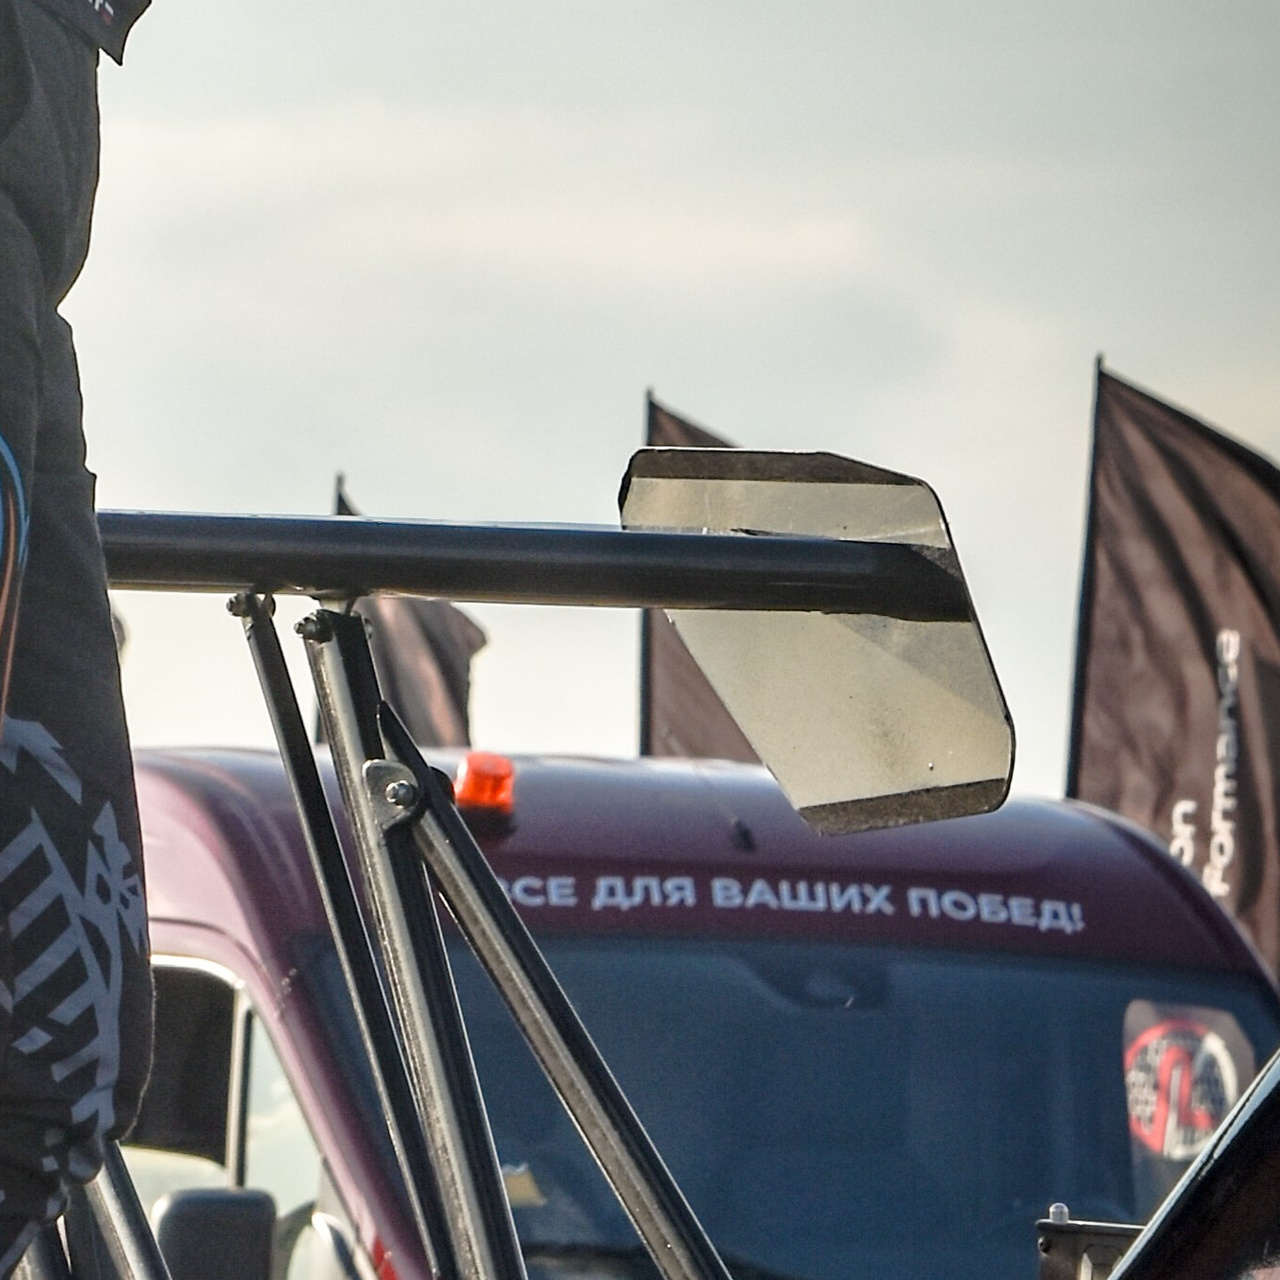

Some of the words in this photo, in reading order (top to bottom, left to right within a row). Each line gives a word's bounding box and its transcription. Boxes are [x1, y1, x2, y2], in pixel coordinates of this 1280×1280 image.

[591, 874, 697, 912] ДЛЯ
[710, 875, 896, 917] ВАШИХ
[906, 886, 1086, 935] ПОБЕД!
